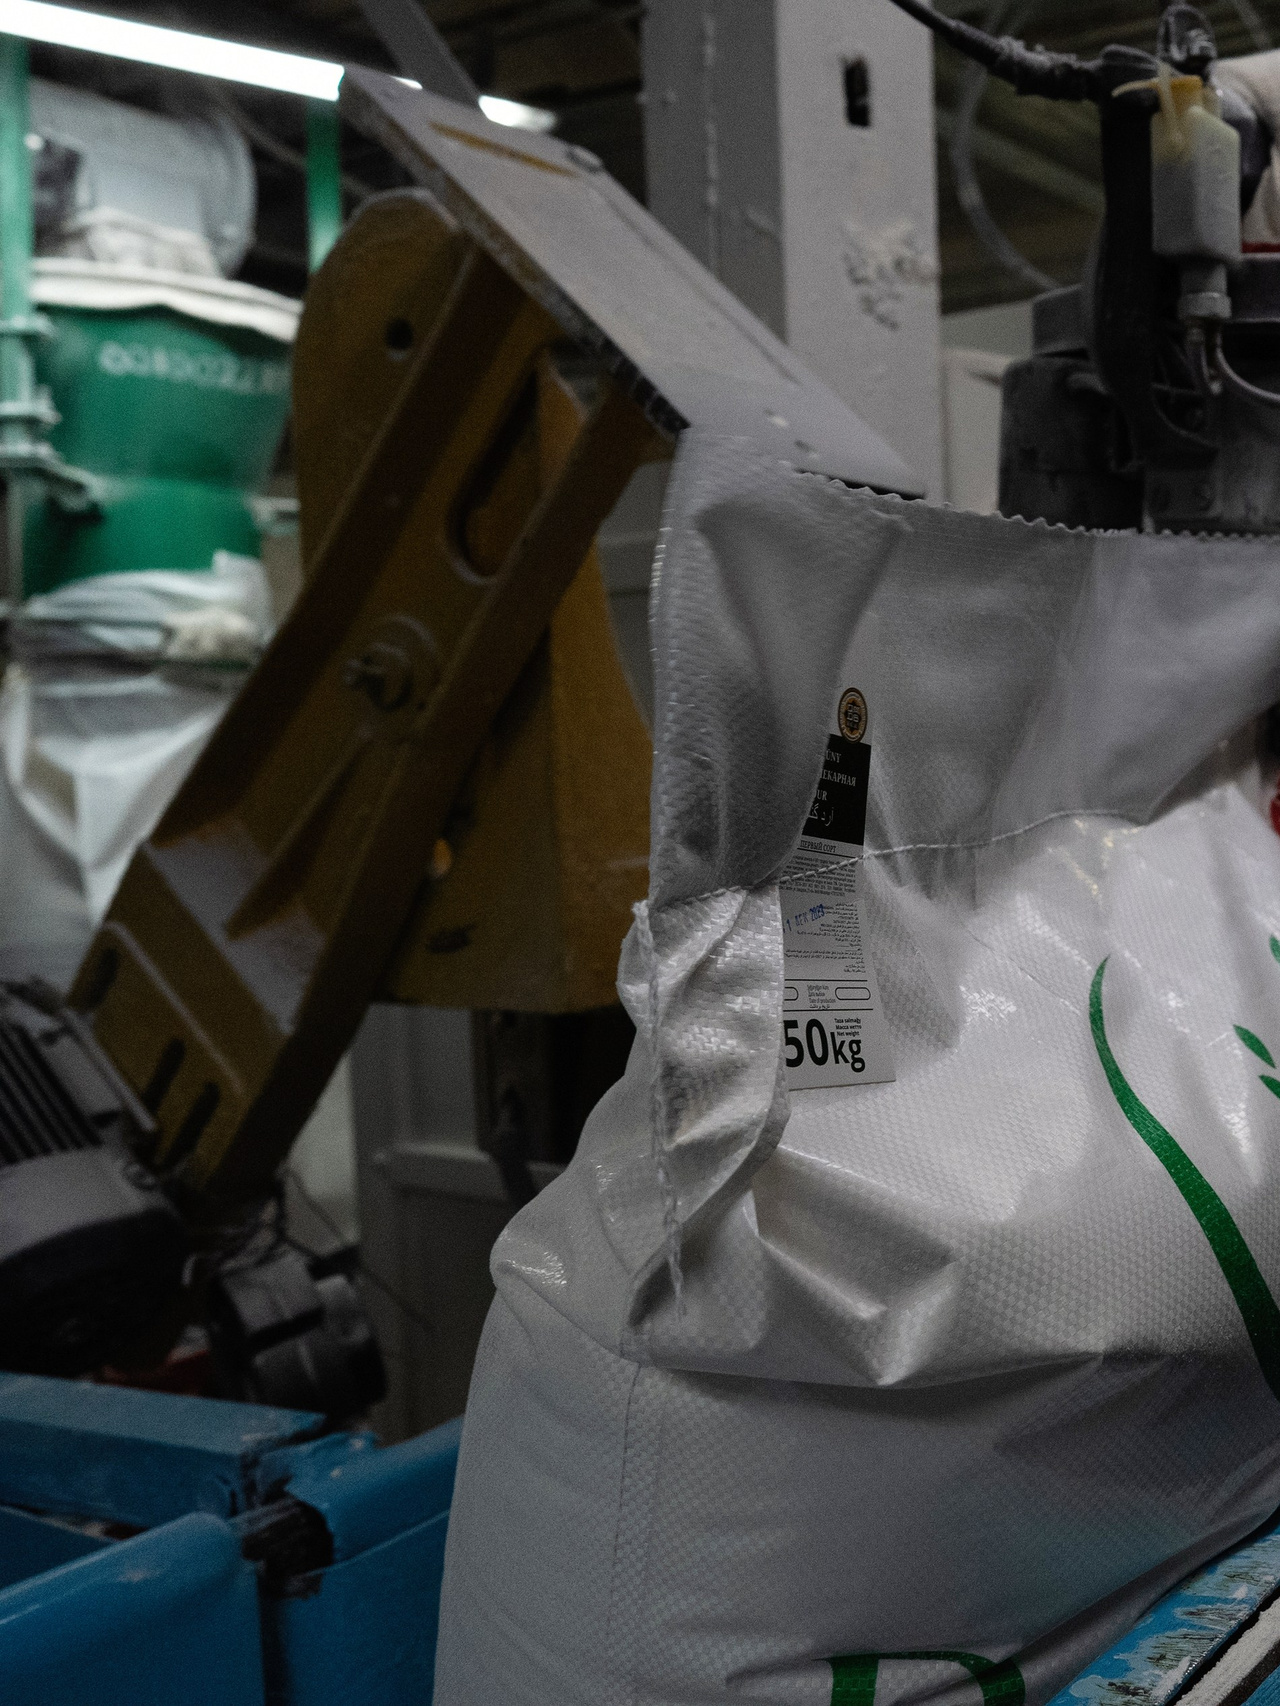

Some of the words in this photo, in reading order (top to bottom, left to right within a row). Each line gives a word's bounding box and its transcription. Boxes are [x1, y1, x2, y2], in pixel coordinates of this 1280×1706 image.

[815, 789, 828, 801] UR
[800, 839, 823, 850] ПЕРВЫЙ
[823, 844, 837, 853] СОРТ
